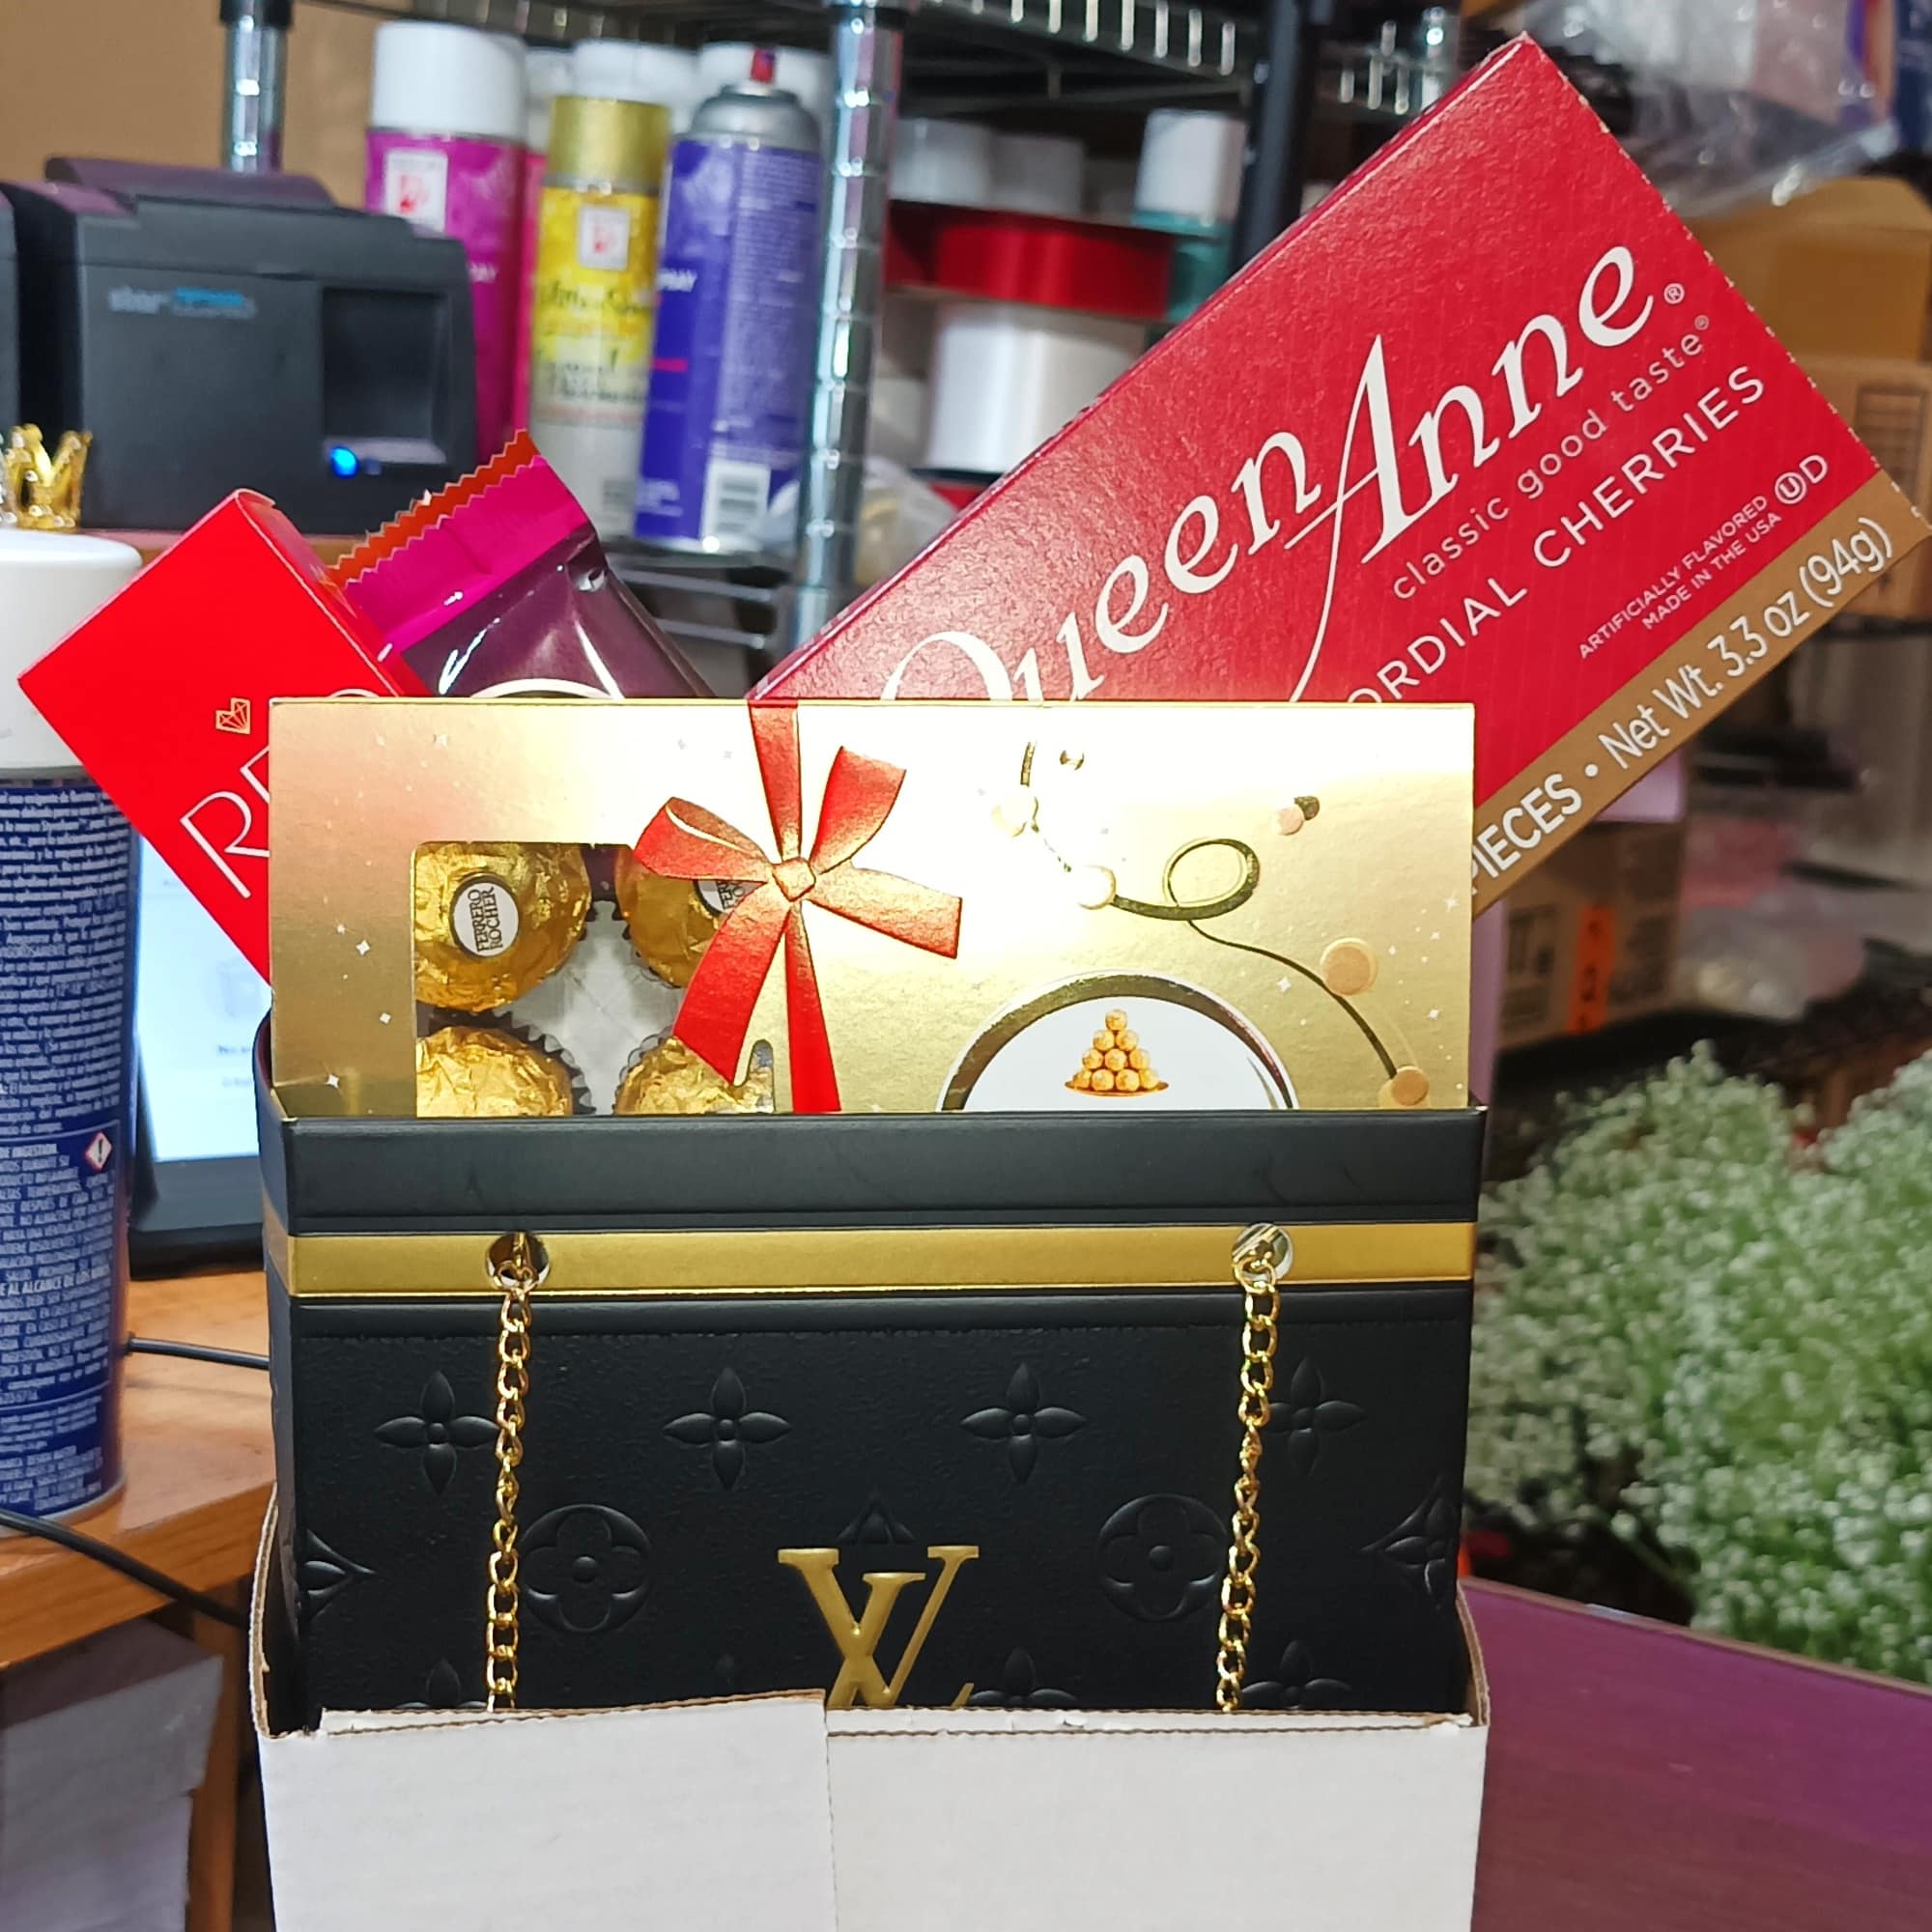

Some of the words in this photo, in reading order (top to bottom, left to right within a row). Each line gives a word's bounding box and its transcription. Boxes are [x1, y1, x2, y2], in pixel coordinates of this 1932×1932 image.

[1392, 497, 1511, 600] classic
[1517, 409, 1607, 499] good
[1533, 365, 1765, 568] CHERRIES
[1578, 565, 1682, 660] ARTIFICIALLY
[1681, 495, 1768, 571] FLAVORED
[1598, 704, 1670, 770] Net
[1651, 664, 1724, 719] Wt.
[1707, 615, 1769, 677] 3.3
[1763, 590, 1810, 638] oz
[1800, 517, 1893, 609] (94g)
[1642, 588, 1692, 630] MADE
[1690, 568, 1713, 590] IN
[1710, 544, 1747, 572] THE
[1745, 512, 1782, 544] USA
[467, 888, 490, 952] FERRERO
[481, 886, 504, 951] ROCHER
